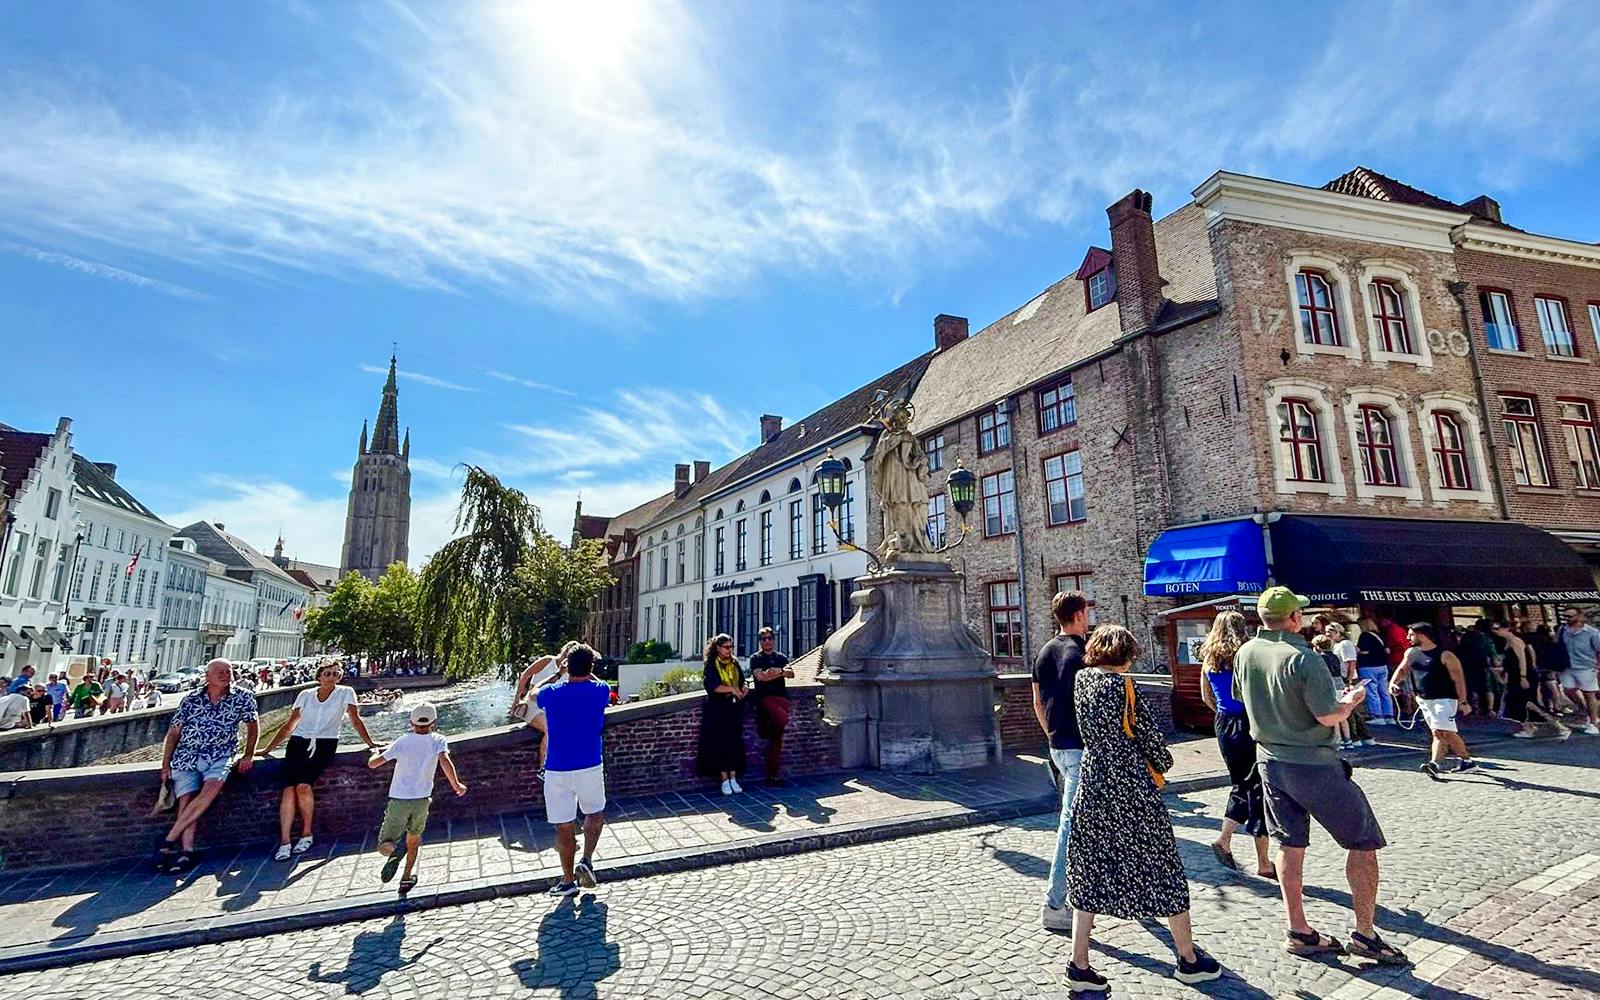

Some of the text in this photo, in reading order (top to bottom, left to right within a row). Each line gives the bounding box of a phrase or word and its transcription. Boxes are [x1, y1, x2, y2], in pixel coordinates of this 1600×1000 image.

[1251, 306, 1285, 336] 17
[1165, 582, 1200, 593] BOTEN
[1237, 581, 1262, 592] BOATS
[1307, 592, 1348, 601] OHOLIC
[1360, 590, 1385, 601] THE
[1385, 591, 1411, 602] BEST
[1413, 591, 1462, 602] BELGIAN
[1461, 591, 1529, 602] CHOCOLATES
